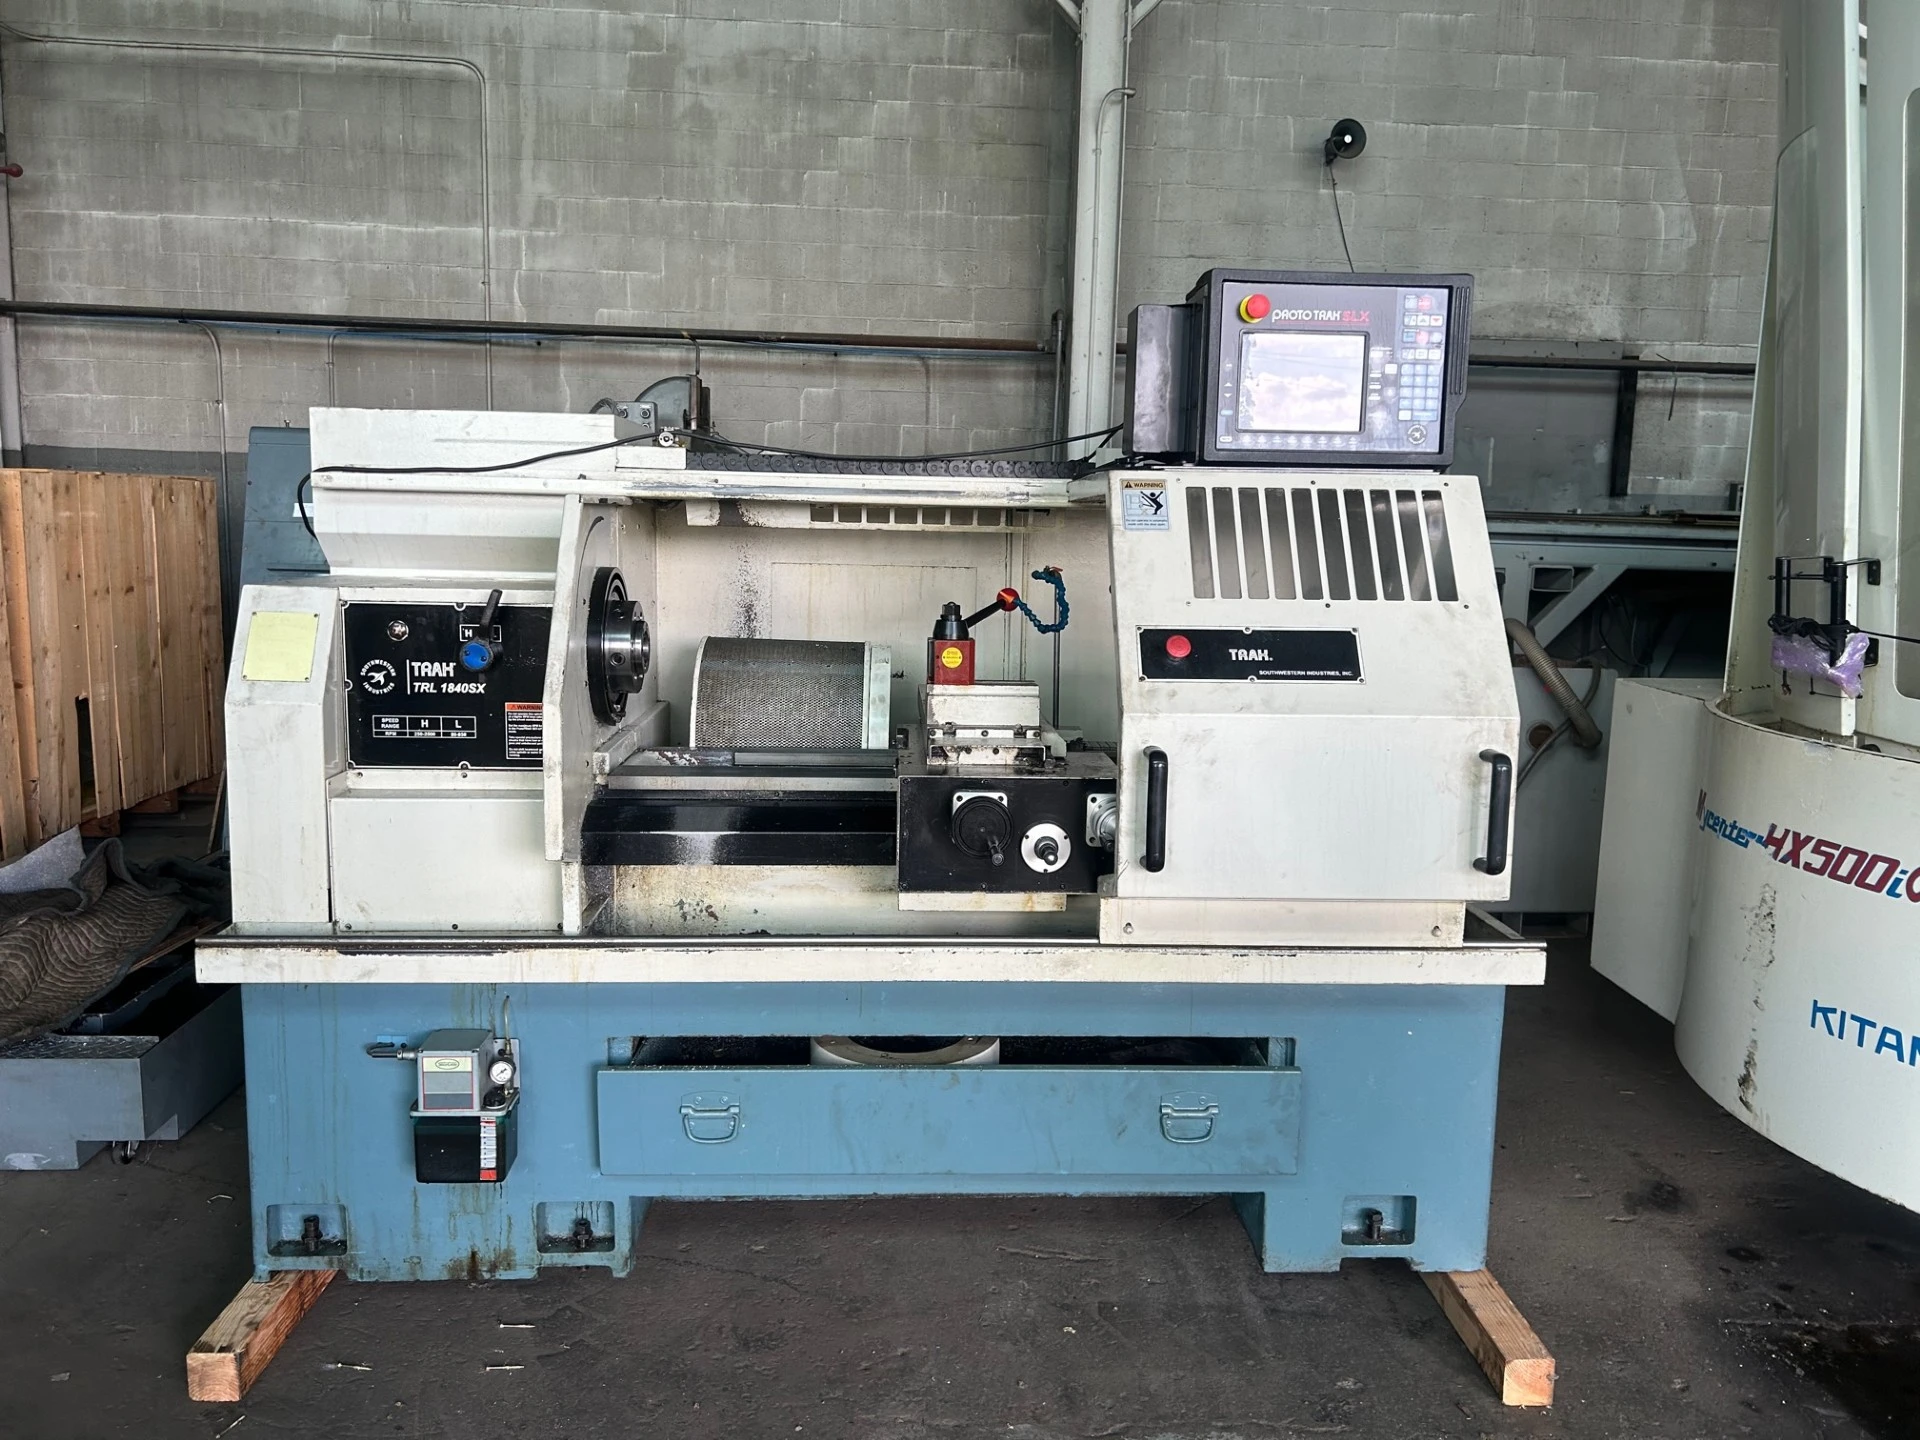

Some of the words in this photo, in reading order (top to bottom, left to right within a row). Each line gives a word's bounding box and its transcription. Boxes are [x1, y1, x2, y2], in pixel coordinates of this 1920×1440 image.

[1271, 308, 1313, 323] PROTO
[1342, 310, 1370, 322] SLX
[464, 628, 473, 638] H
[360, 659, 397, 677] SOUTHWESTERN
[362, 681, 396, 695] INDUSTRIES
[412, 682, 438, 694] TRL
[440, 682, 487, 694] 1840SX
[420, 719, 429, 728] H
[454, 719, 462, 729] L
